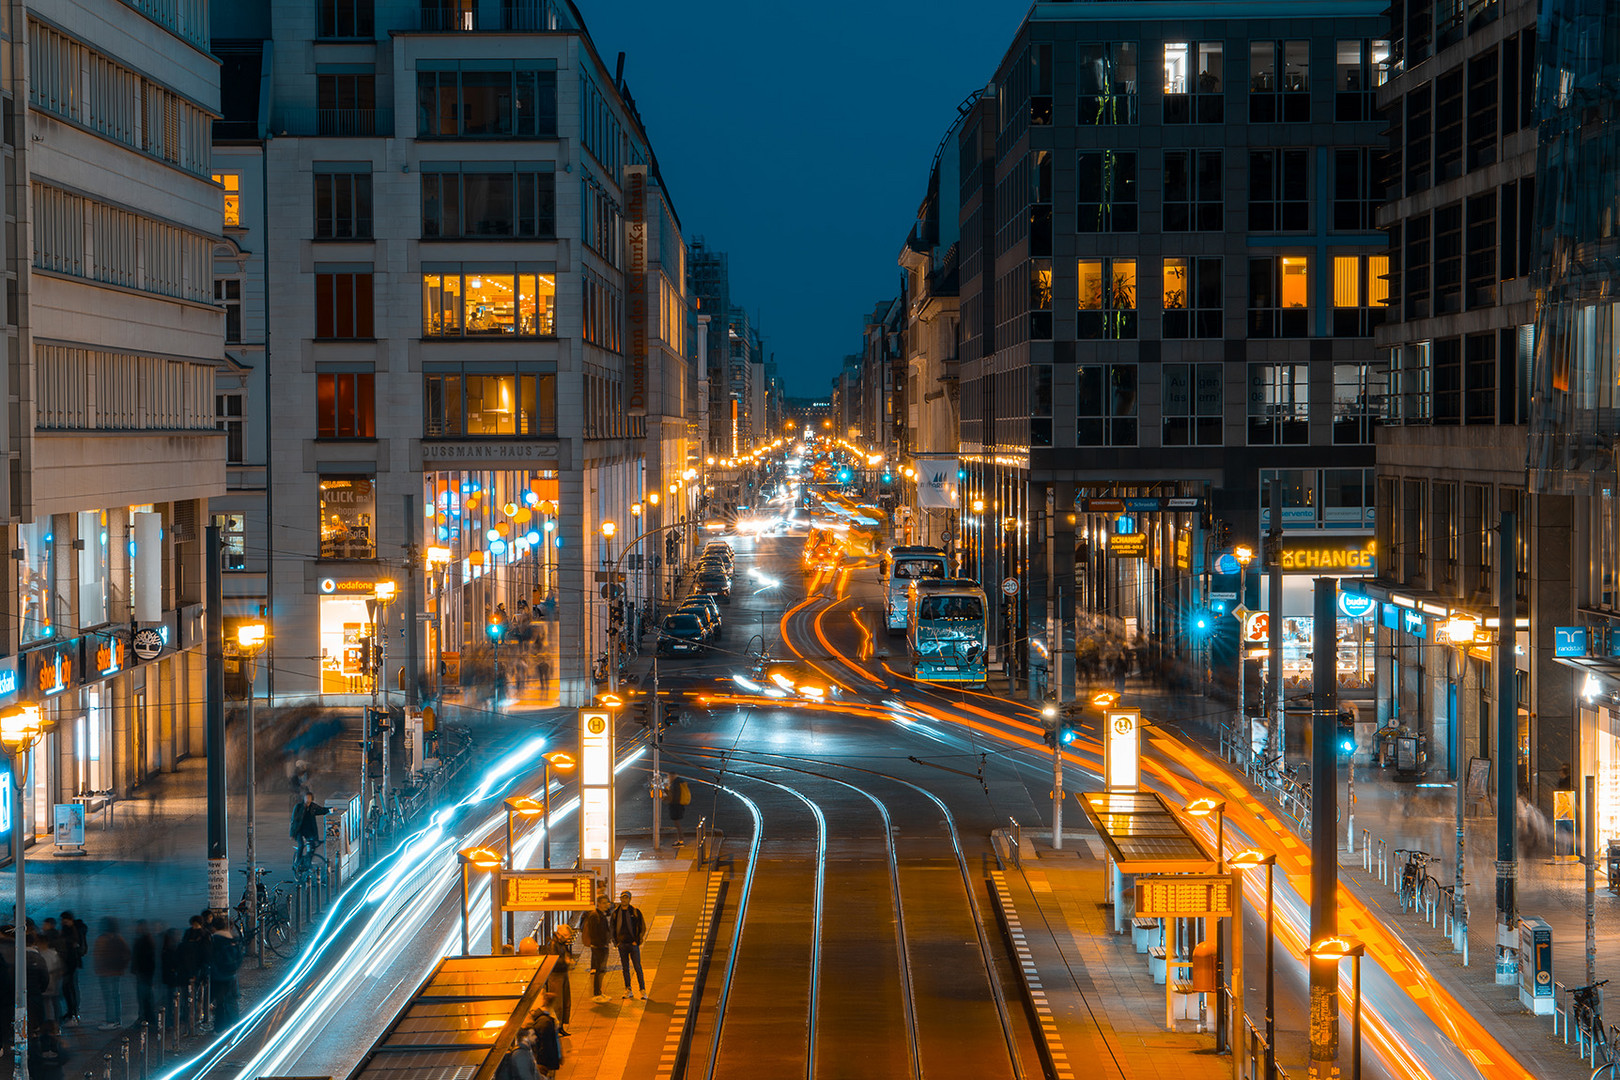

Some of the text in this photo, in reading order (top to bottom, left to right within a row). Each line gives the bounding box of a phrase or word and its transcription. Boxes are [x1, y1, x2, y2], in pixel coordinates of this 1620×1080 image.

[629, 298, 644, 324] das
[629, 329, 644, 409] Dussmann
[423, 446, 532, 457] DUSSMANN-HAUS
[323, 491, 354, 503] KLICK
[336, 581, 373, 590] vodafone
[1006, 582, 1016, 591] 30
